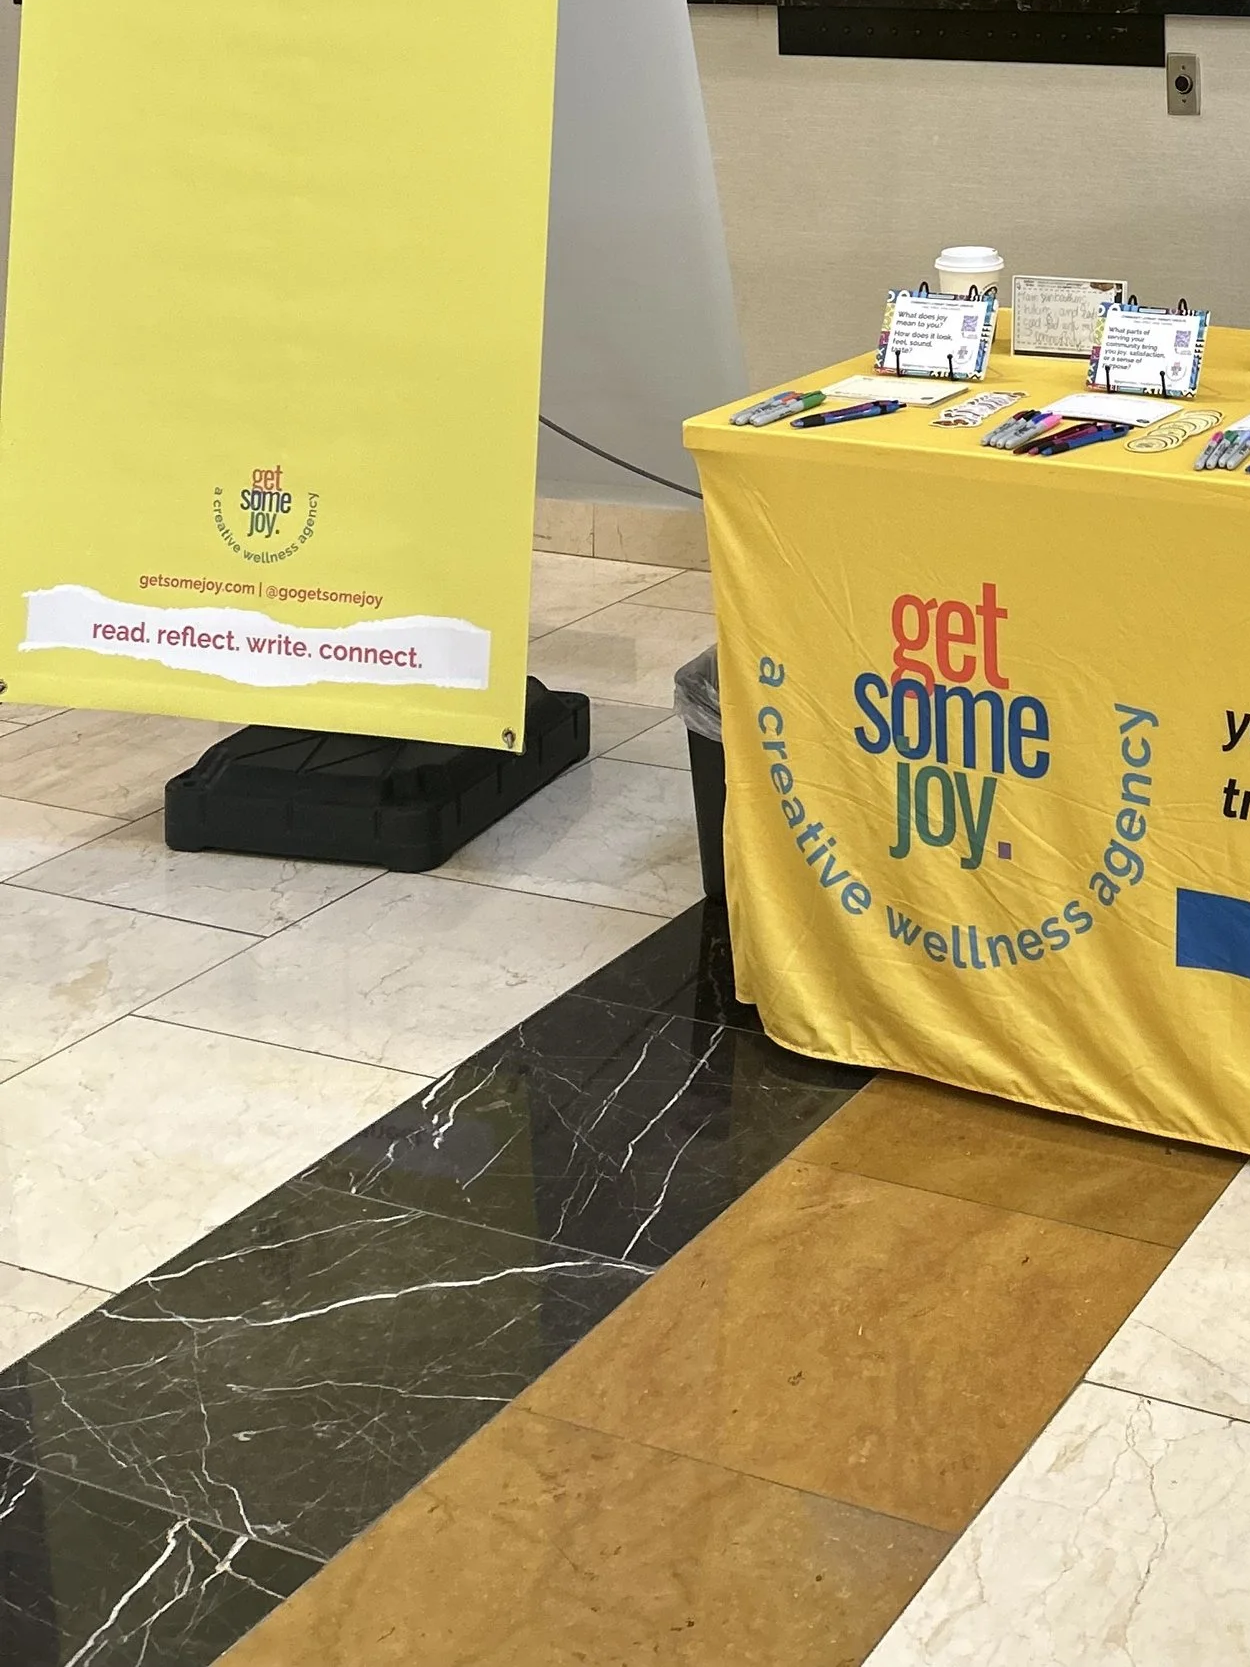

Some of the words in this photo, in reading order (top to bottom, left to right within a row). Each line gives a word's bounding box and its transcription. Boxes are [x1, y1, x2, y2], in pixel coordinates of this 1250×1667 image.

[215, 487, 223, 495] a
[240, 489, 292, 513] some
[252, 465, 283, 493] get
[213, 500, 241, 553] creative
[247, 512, 280, 538] joy.
[298, 492, 320, 544] agency
[244, 543, 299, 564] wellness
[139, 575, 255, 595] getsomejoy.com
[266, 586, 383, 610] @gogetsomejoy
[92, 622, 150, 644] read.
[156, 626, 240, 652] reflect.
[246, 635, 312, 658] write.
[319, 643, 423, 669] connect.
[890, 582, 1009, 699] get
[758, 655, 786, 688] a
[853, 672, 1051, 779] some
[757, 705, 872, 915] creative
[889, 736, 1012, 870] joy.
[1088, 702, 1159, 906] agency
[886, 900, 1094, 970] wellness
